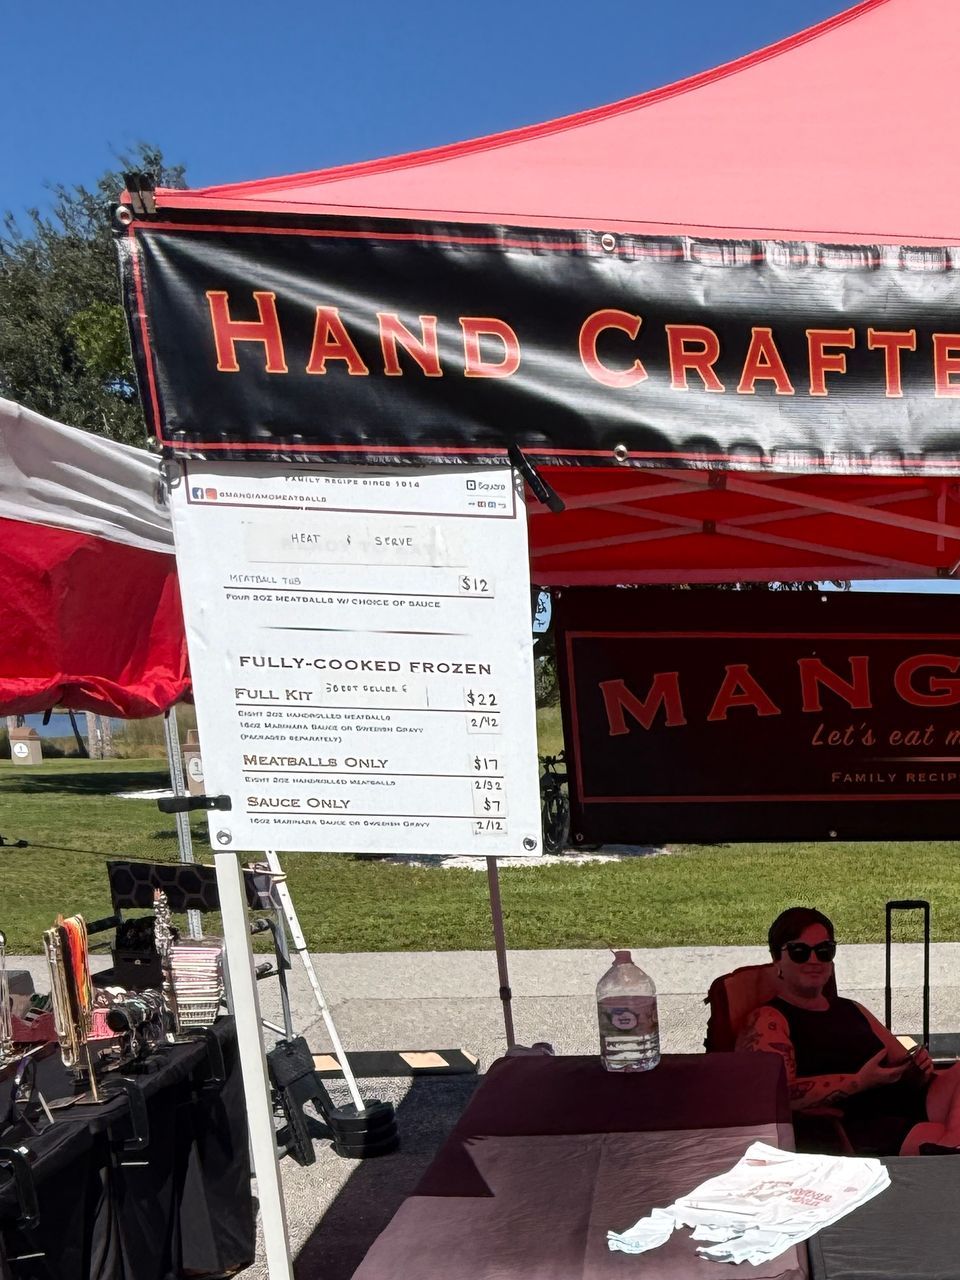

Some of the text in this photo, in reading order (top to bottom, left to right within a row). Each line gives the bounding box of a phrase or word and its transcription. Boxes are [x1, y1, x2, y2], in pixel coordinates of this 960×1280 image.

[205, 290, 522, 379] HAND
[291, 532, 321, 544] HEAT
[375, 536, 413, 547] SERVE
[229, 574, 302, 586] MEATBALL TUB
[461, 575, 489, 592] $12
[275, 595, 334, 604] MEATBALLS
[351, 598, 389, 607] CHOICE
[239, 655, 492, 675] FULLY-COOKED FROZEN
[234, 687, 314, 701] FULL KIT
[466, 689, 498, 707] $22
[470, 716, 499, 729] 2/42
[811, 721, 877, 747] Let's
[889, 723, 936, 747] eat
[243, 754, 389, 769] MEATBALLS ONLY
[474, 755, 498, 771] $17
[832, 771, 897, 783] FAMILY
[247, 795, 351, 809] SAUCE ONLY
[484, 797, 501, 812] $7
[476, 821, 503, 831] 2/12
